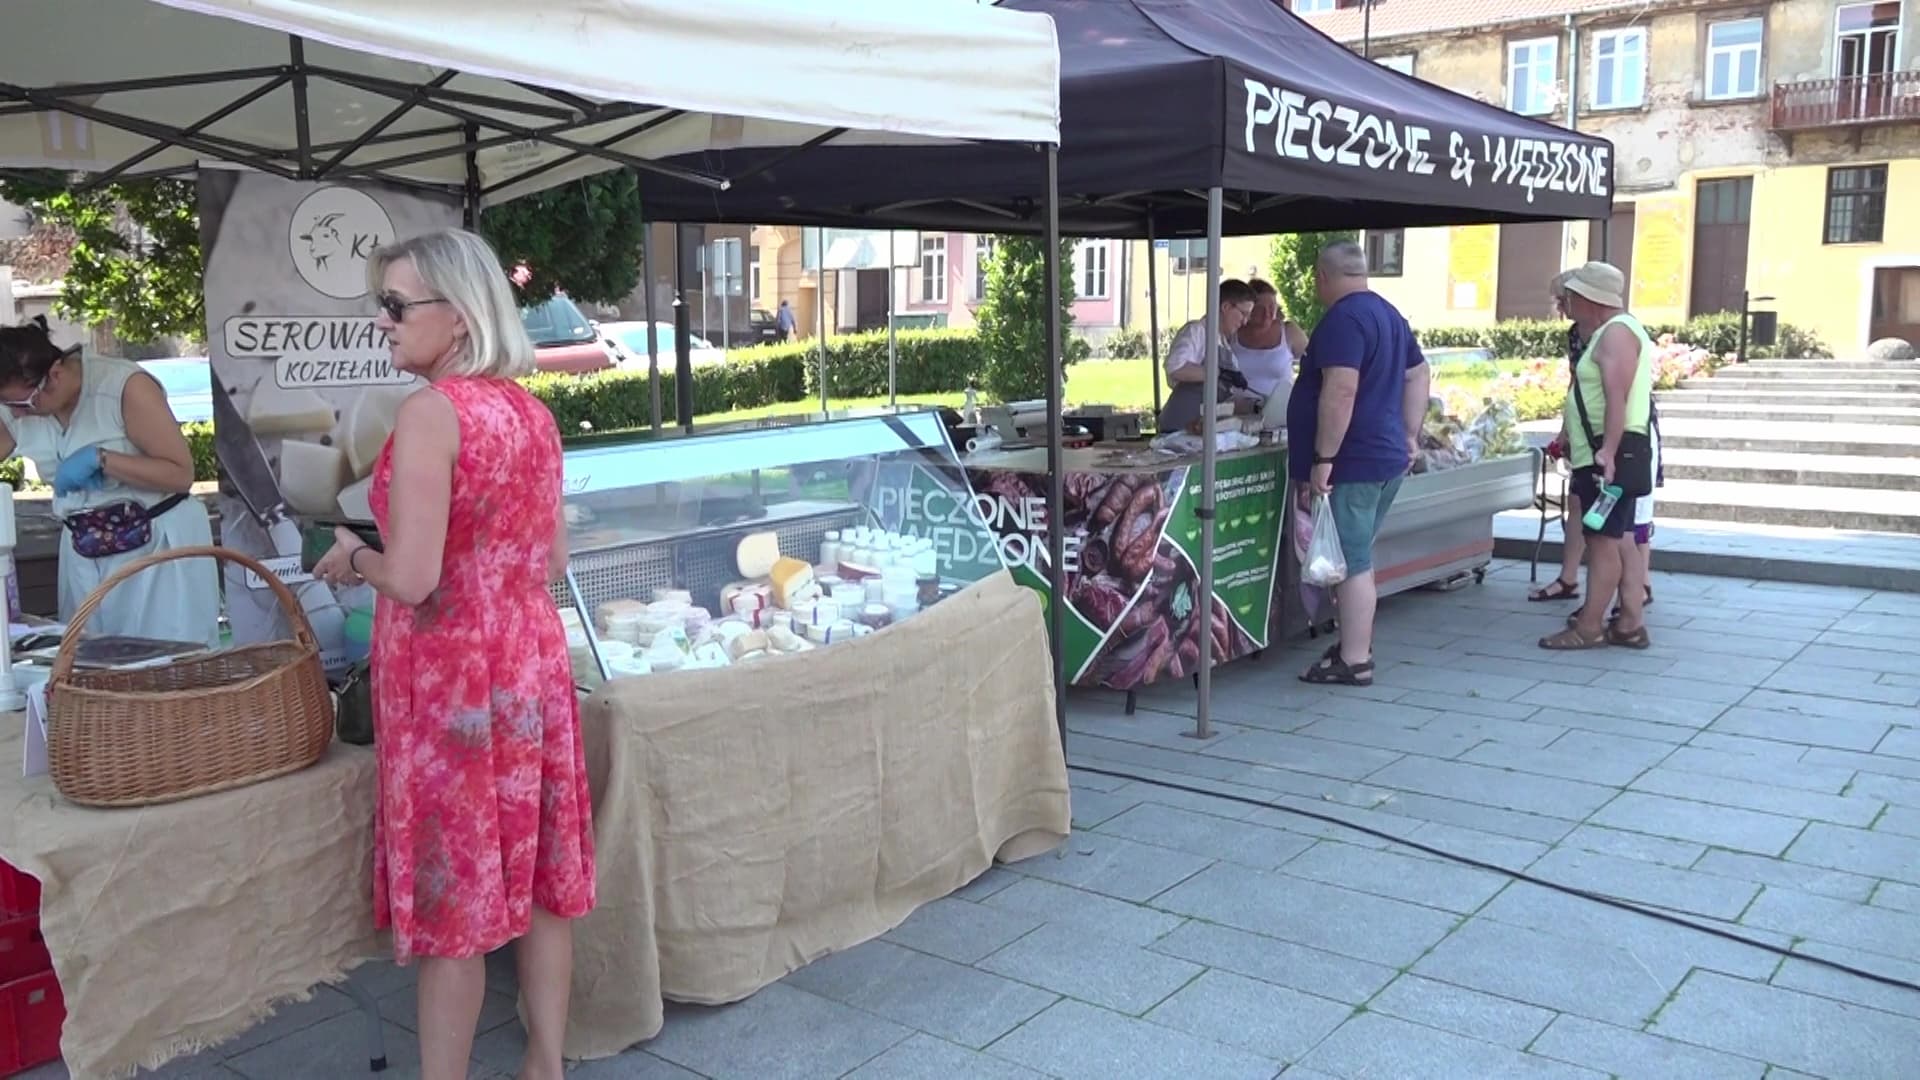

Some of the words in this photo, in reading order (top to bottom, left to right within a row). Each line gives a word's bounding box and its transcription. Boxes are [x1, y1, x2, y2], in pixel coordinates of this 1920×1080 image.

[1244, 79, 1436, 175] PIECZONE
[1449, 131, 1476, 187] &
[1482, 135, 1609, 203] WĘDZONE
[879, 488, 1047, 530] PIECZONE
